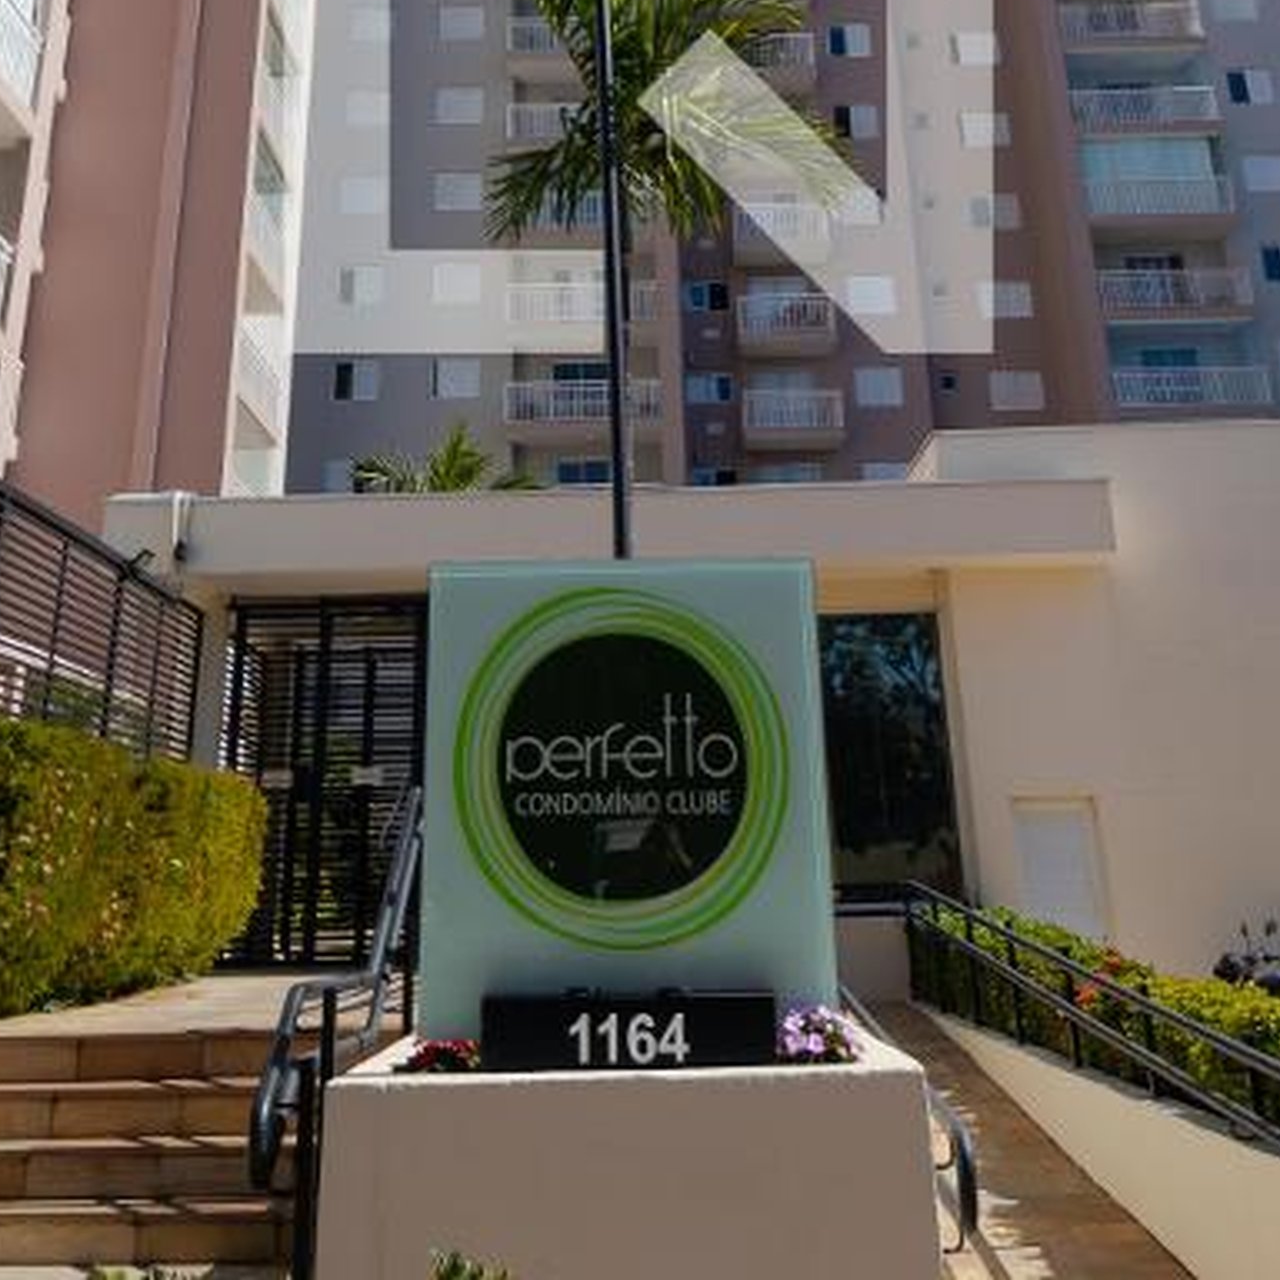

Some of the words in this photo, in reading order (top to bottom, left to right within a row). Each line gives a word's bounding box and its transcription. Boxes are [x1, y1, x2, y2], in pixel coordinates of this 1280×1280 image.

[506, 693, 738, 782] perfetto
[515, 785, 661, 816] CONDOMÍNIO
[666, 790, 732, 815] CLUBE
[569, 1012, 690, 1065] 1164
